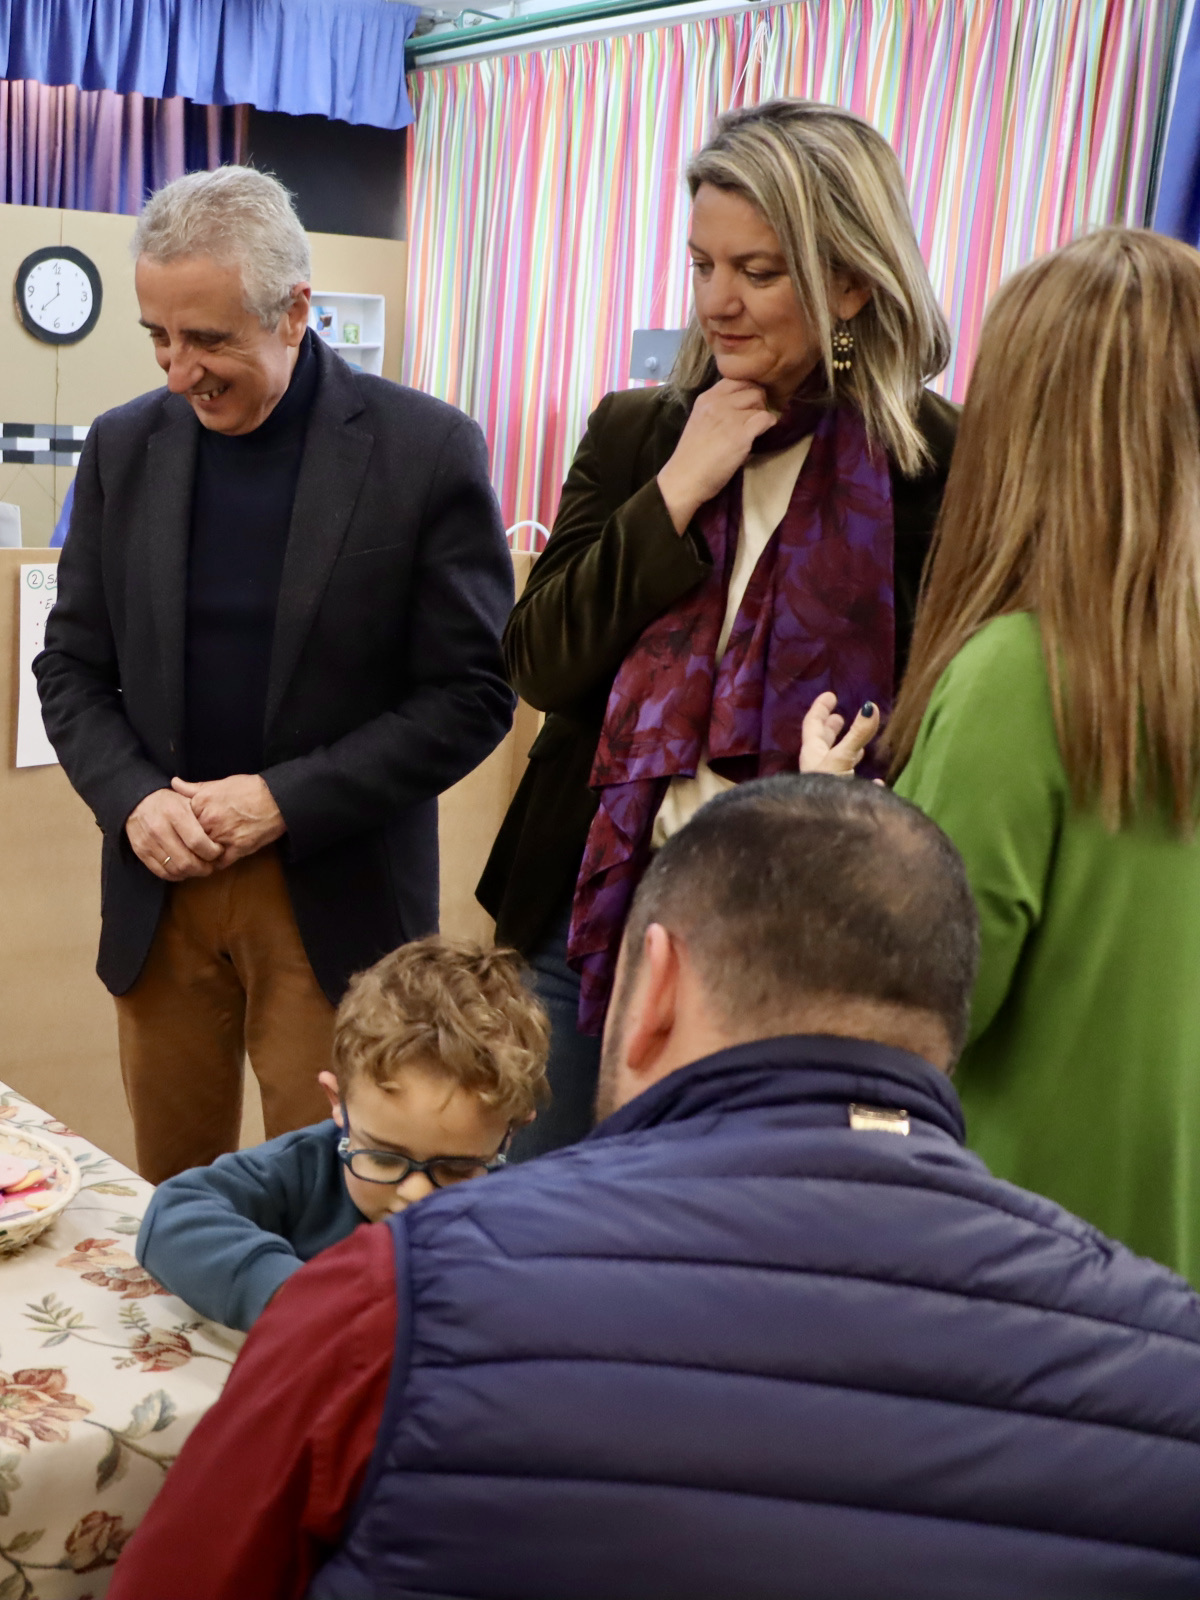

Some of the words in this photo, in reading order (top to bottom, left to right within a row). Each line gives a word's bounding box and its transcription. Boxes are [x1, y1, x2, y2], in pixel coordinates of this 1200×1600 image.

[53, 262, 62, 275] 12
[28, 285, 35, 298] 9
[80, 291, 88, 302] 3
[53, 317, 61, 329] 6
